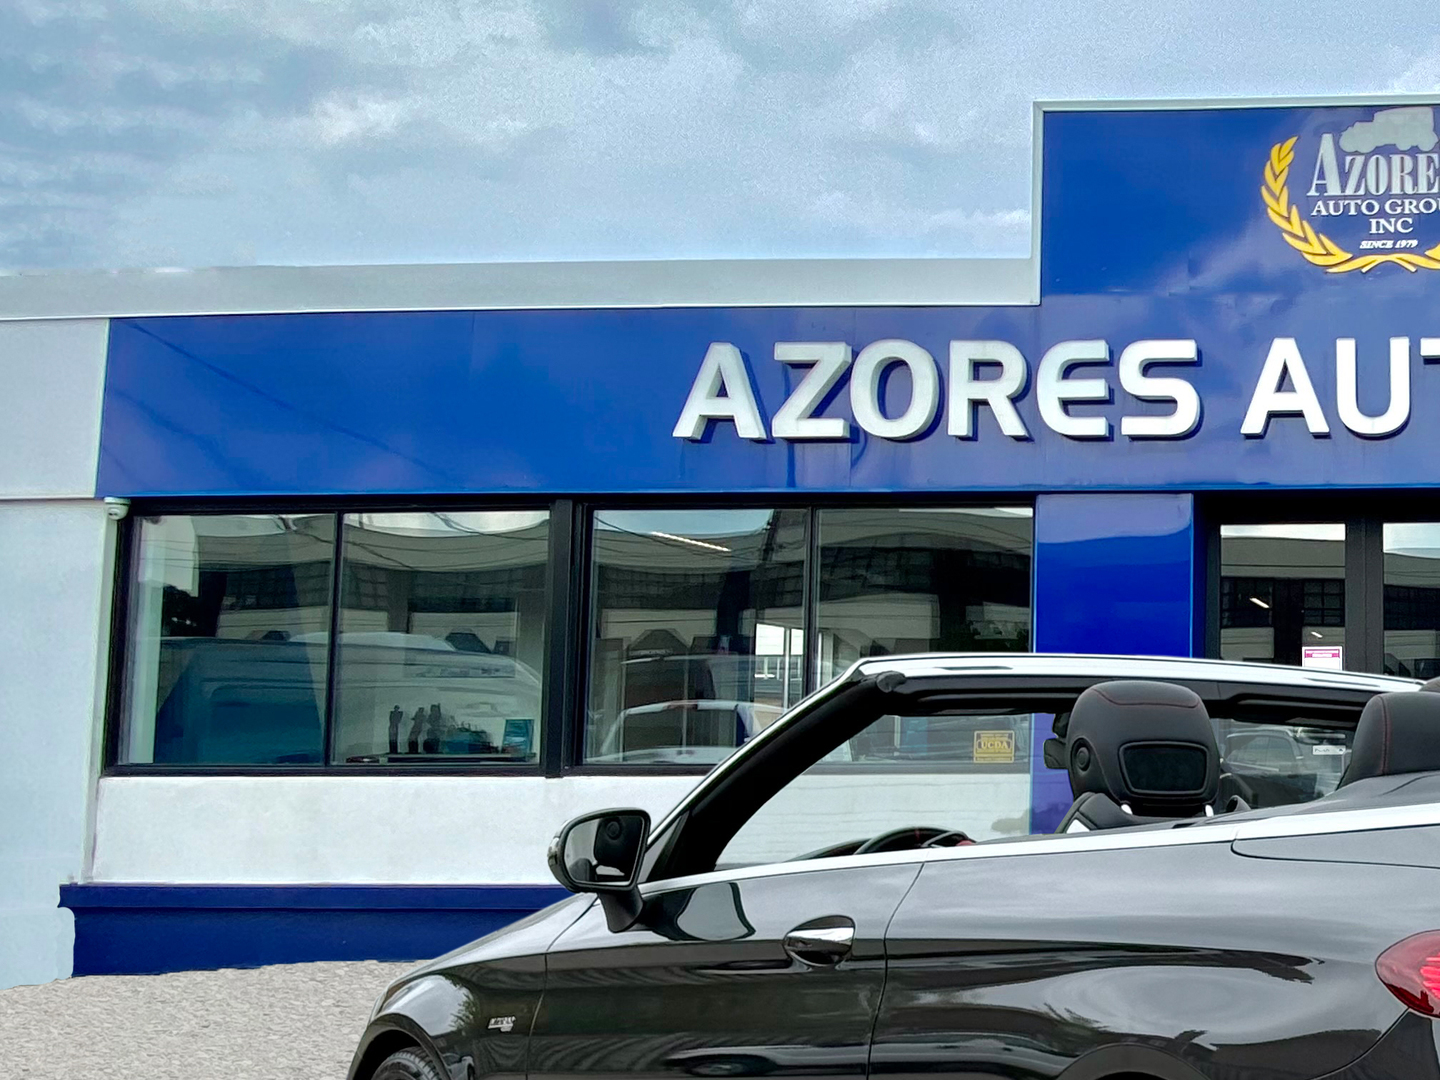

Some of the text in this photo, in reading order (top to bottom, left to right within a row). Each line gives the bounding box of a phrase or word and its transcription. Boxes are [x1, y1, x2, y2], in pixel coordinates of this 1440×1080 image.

[1311, 199, 1380, 216] AUTO
[1369, 217, 1414, 234] INC
[1359, 239, 1418, 249] SINCE 1979
[672, 338, 1201, 442] AZORES
[981, 740, 1009, 750] UCDA
